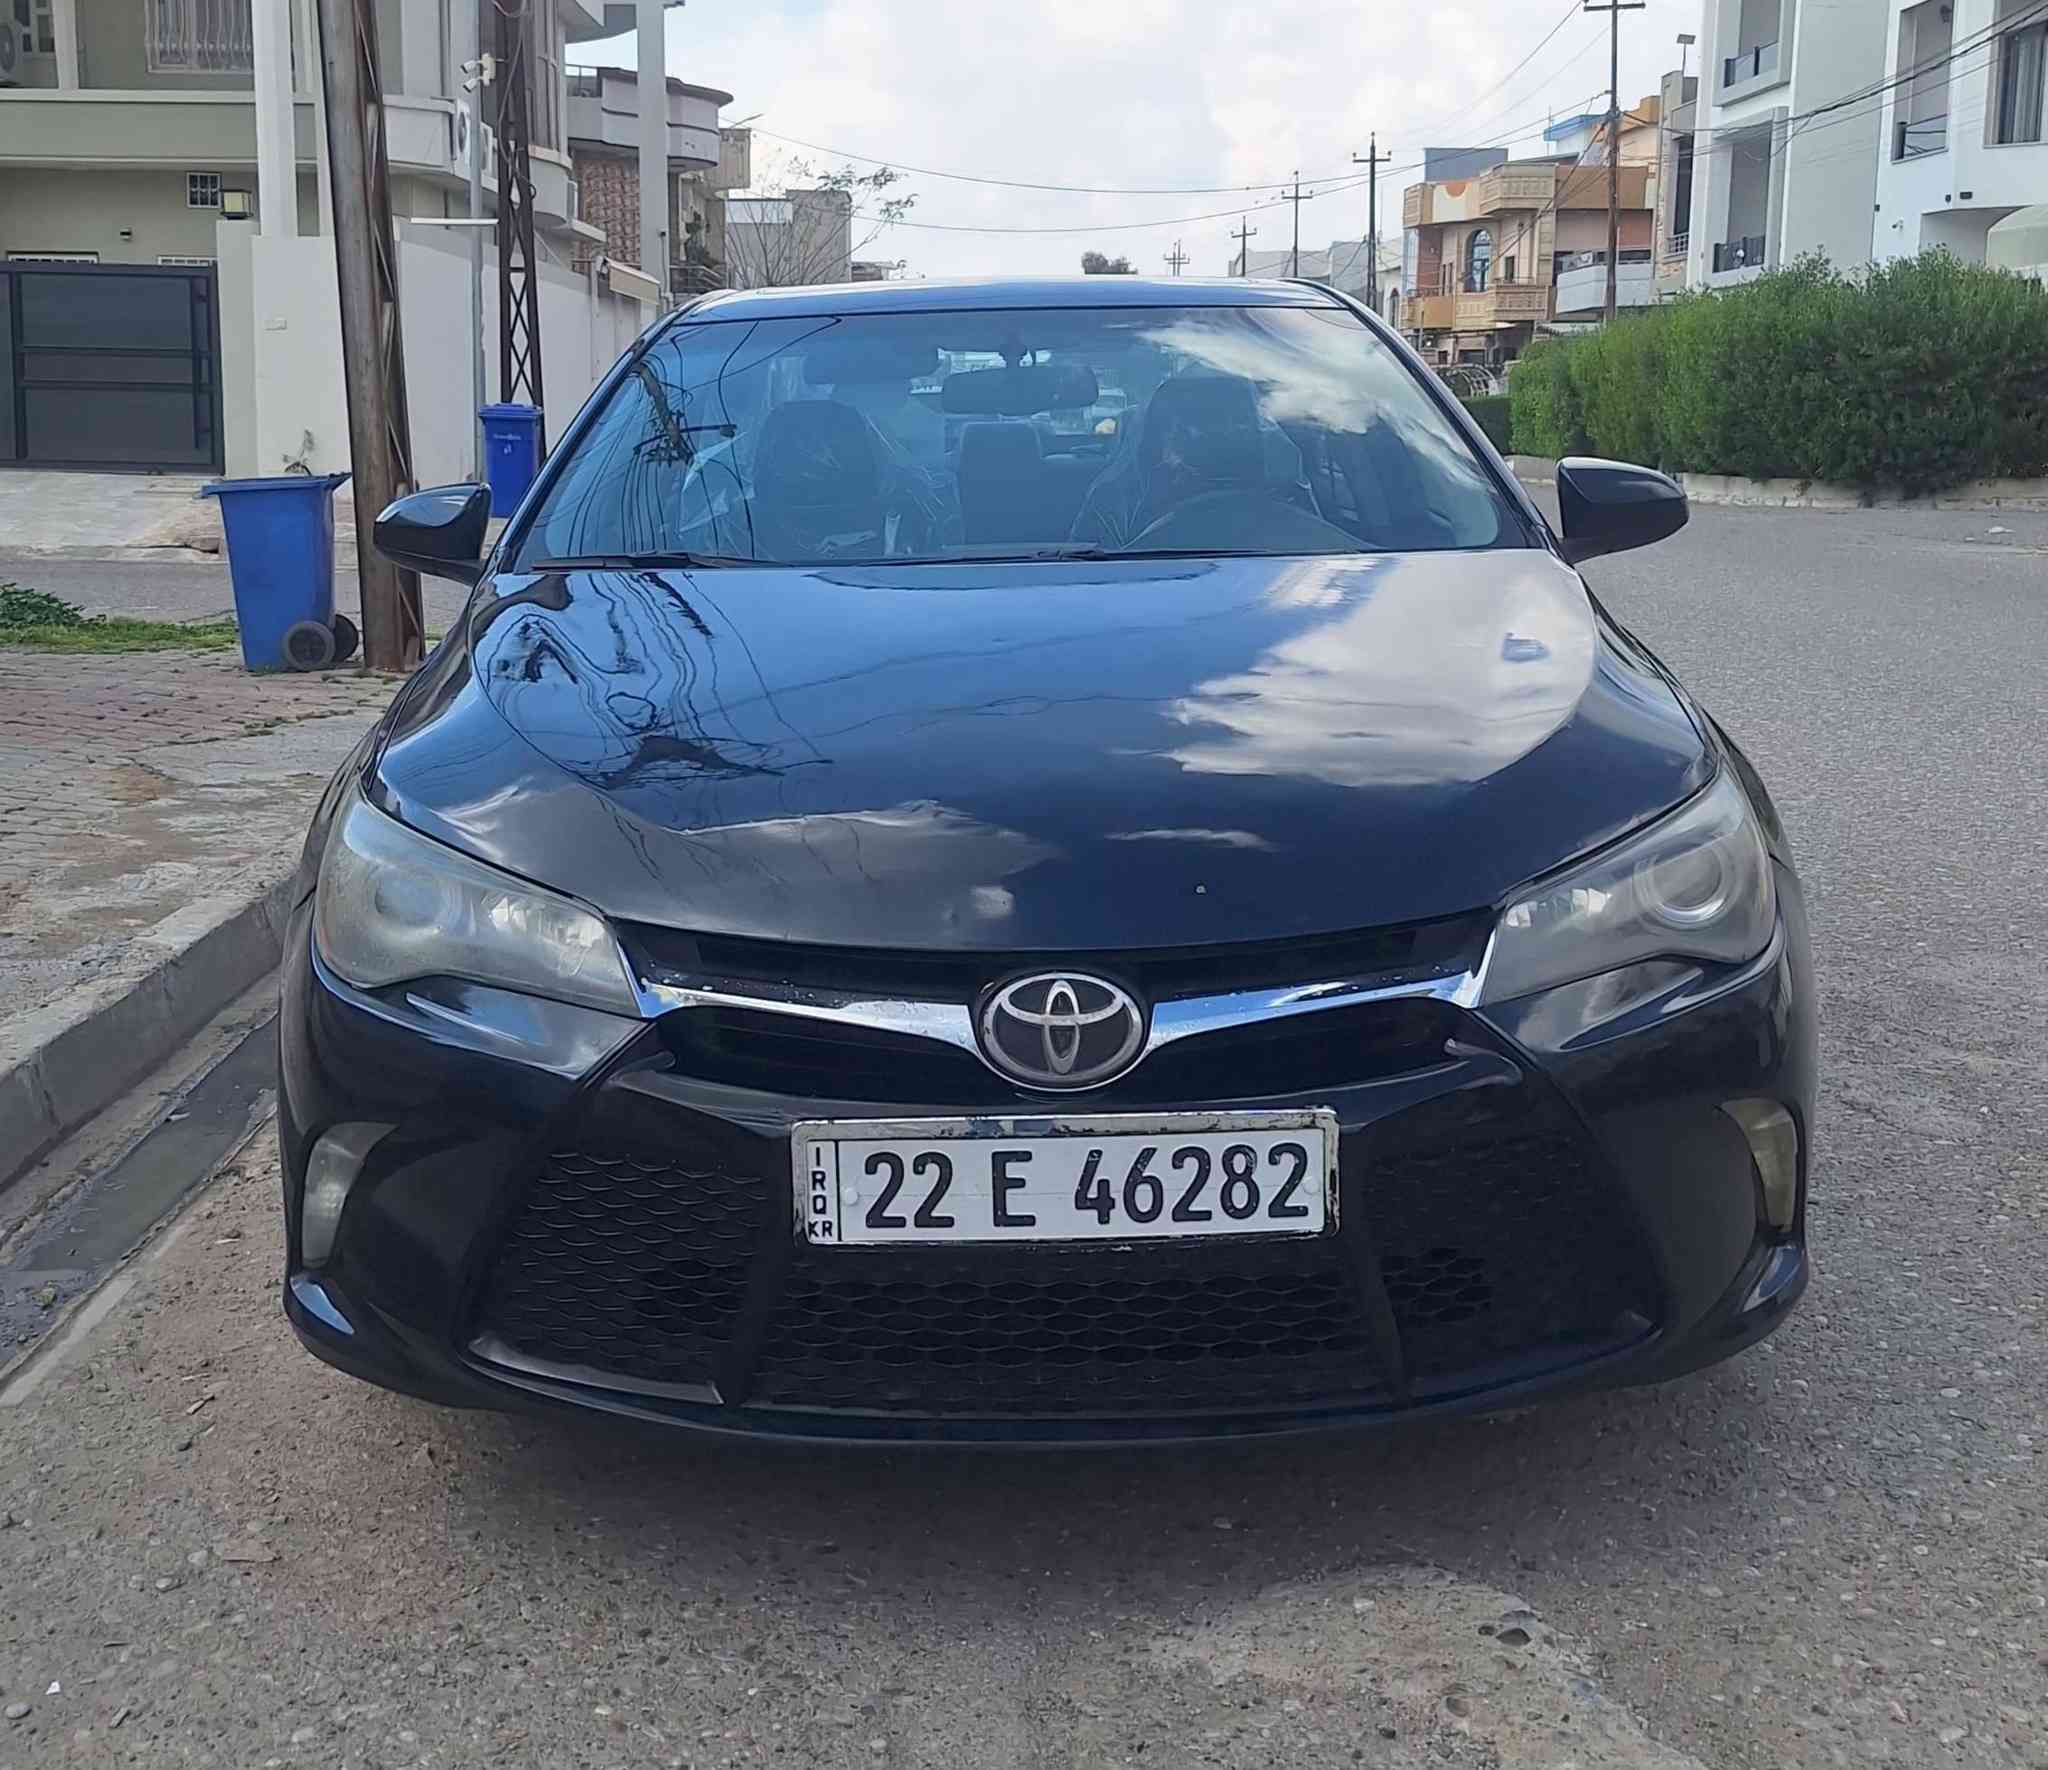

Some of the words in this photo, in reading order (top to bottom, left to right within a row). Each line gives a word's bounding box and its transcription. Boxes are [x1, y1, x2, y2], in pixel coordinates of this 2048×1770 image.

[811, 1147, 827, 1215] IRQ
[864, 1151, 955, 1228] 22
[991, 1150, 1036, 1228] E
[1074, 1143, 1308, 1224] 46282
[807, 1220, 833, 1238] KR
